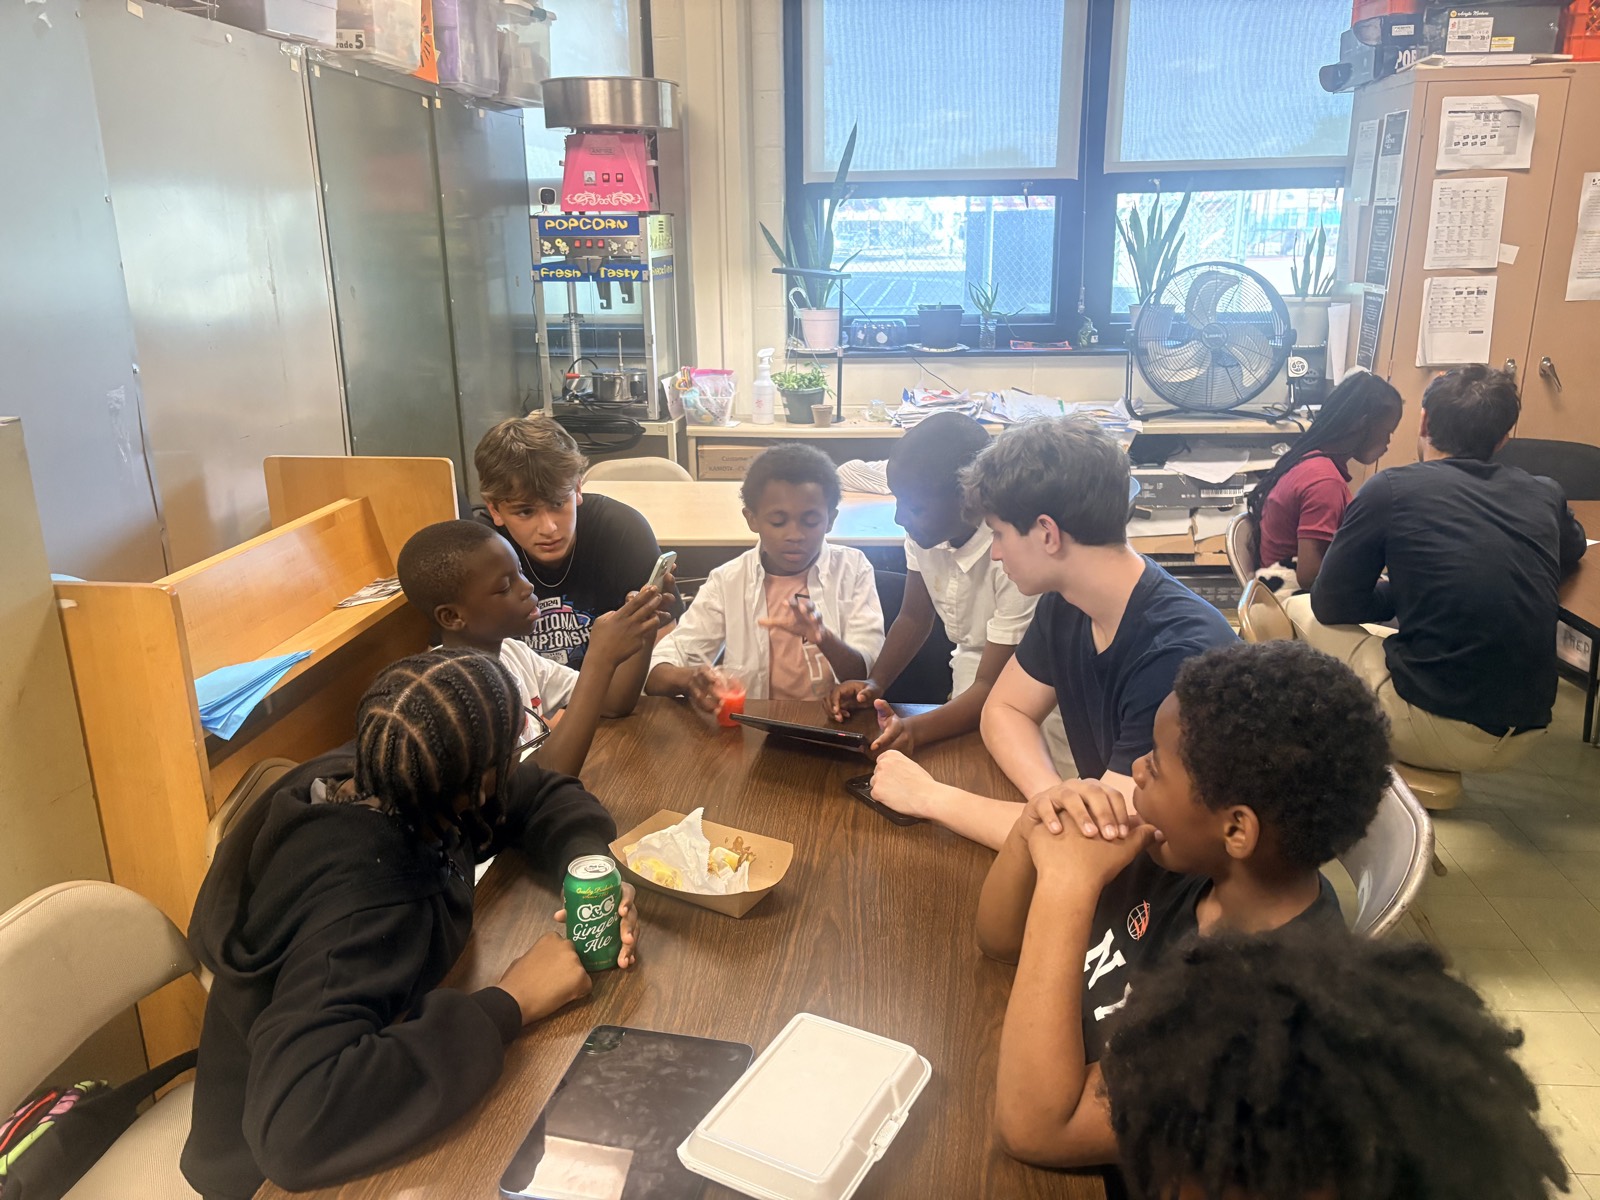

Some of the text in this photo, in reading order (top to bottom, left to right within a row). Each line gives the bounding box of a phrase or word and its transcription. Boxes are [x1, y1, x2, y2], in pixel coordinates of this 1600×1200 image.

[336, 41, 353, 49] rade
[355, 33, 364, 49] 5
[545, 217, 628, 231] POPCORN
[540, 267, 582, 278] Fresh
[599, 266, 640, 280] Tasty
[540, 599, 558, 609] 2024
[533, 612, 583, 635] TIONAL
[577, 894, 616, 922] C&C
[583, 935, 613, 953] Ale
